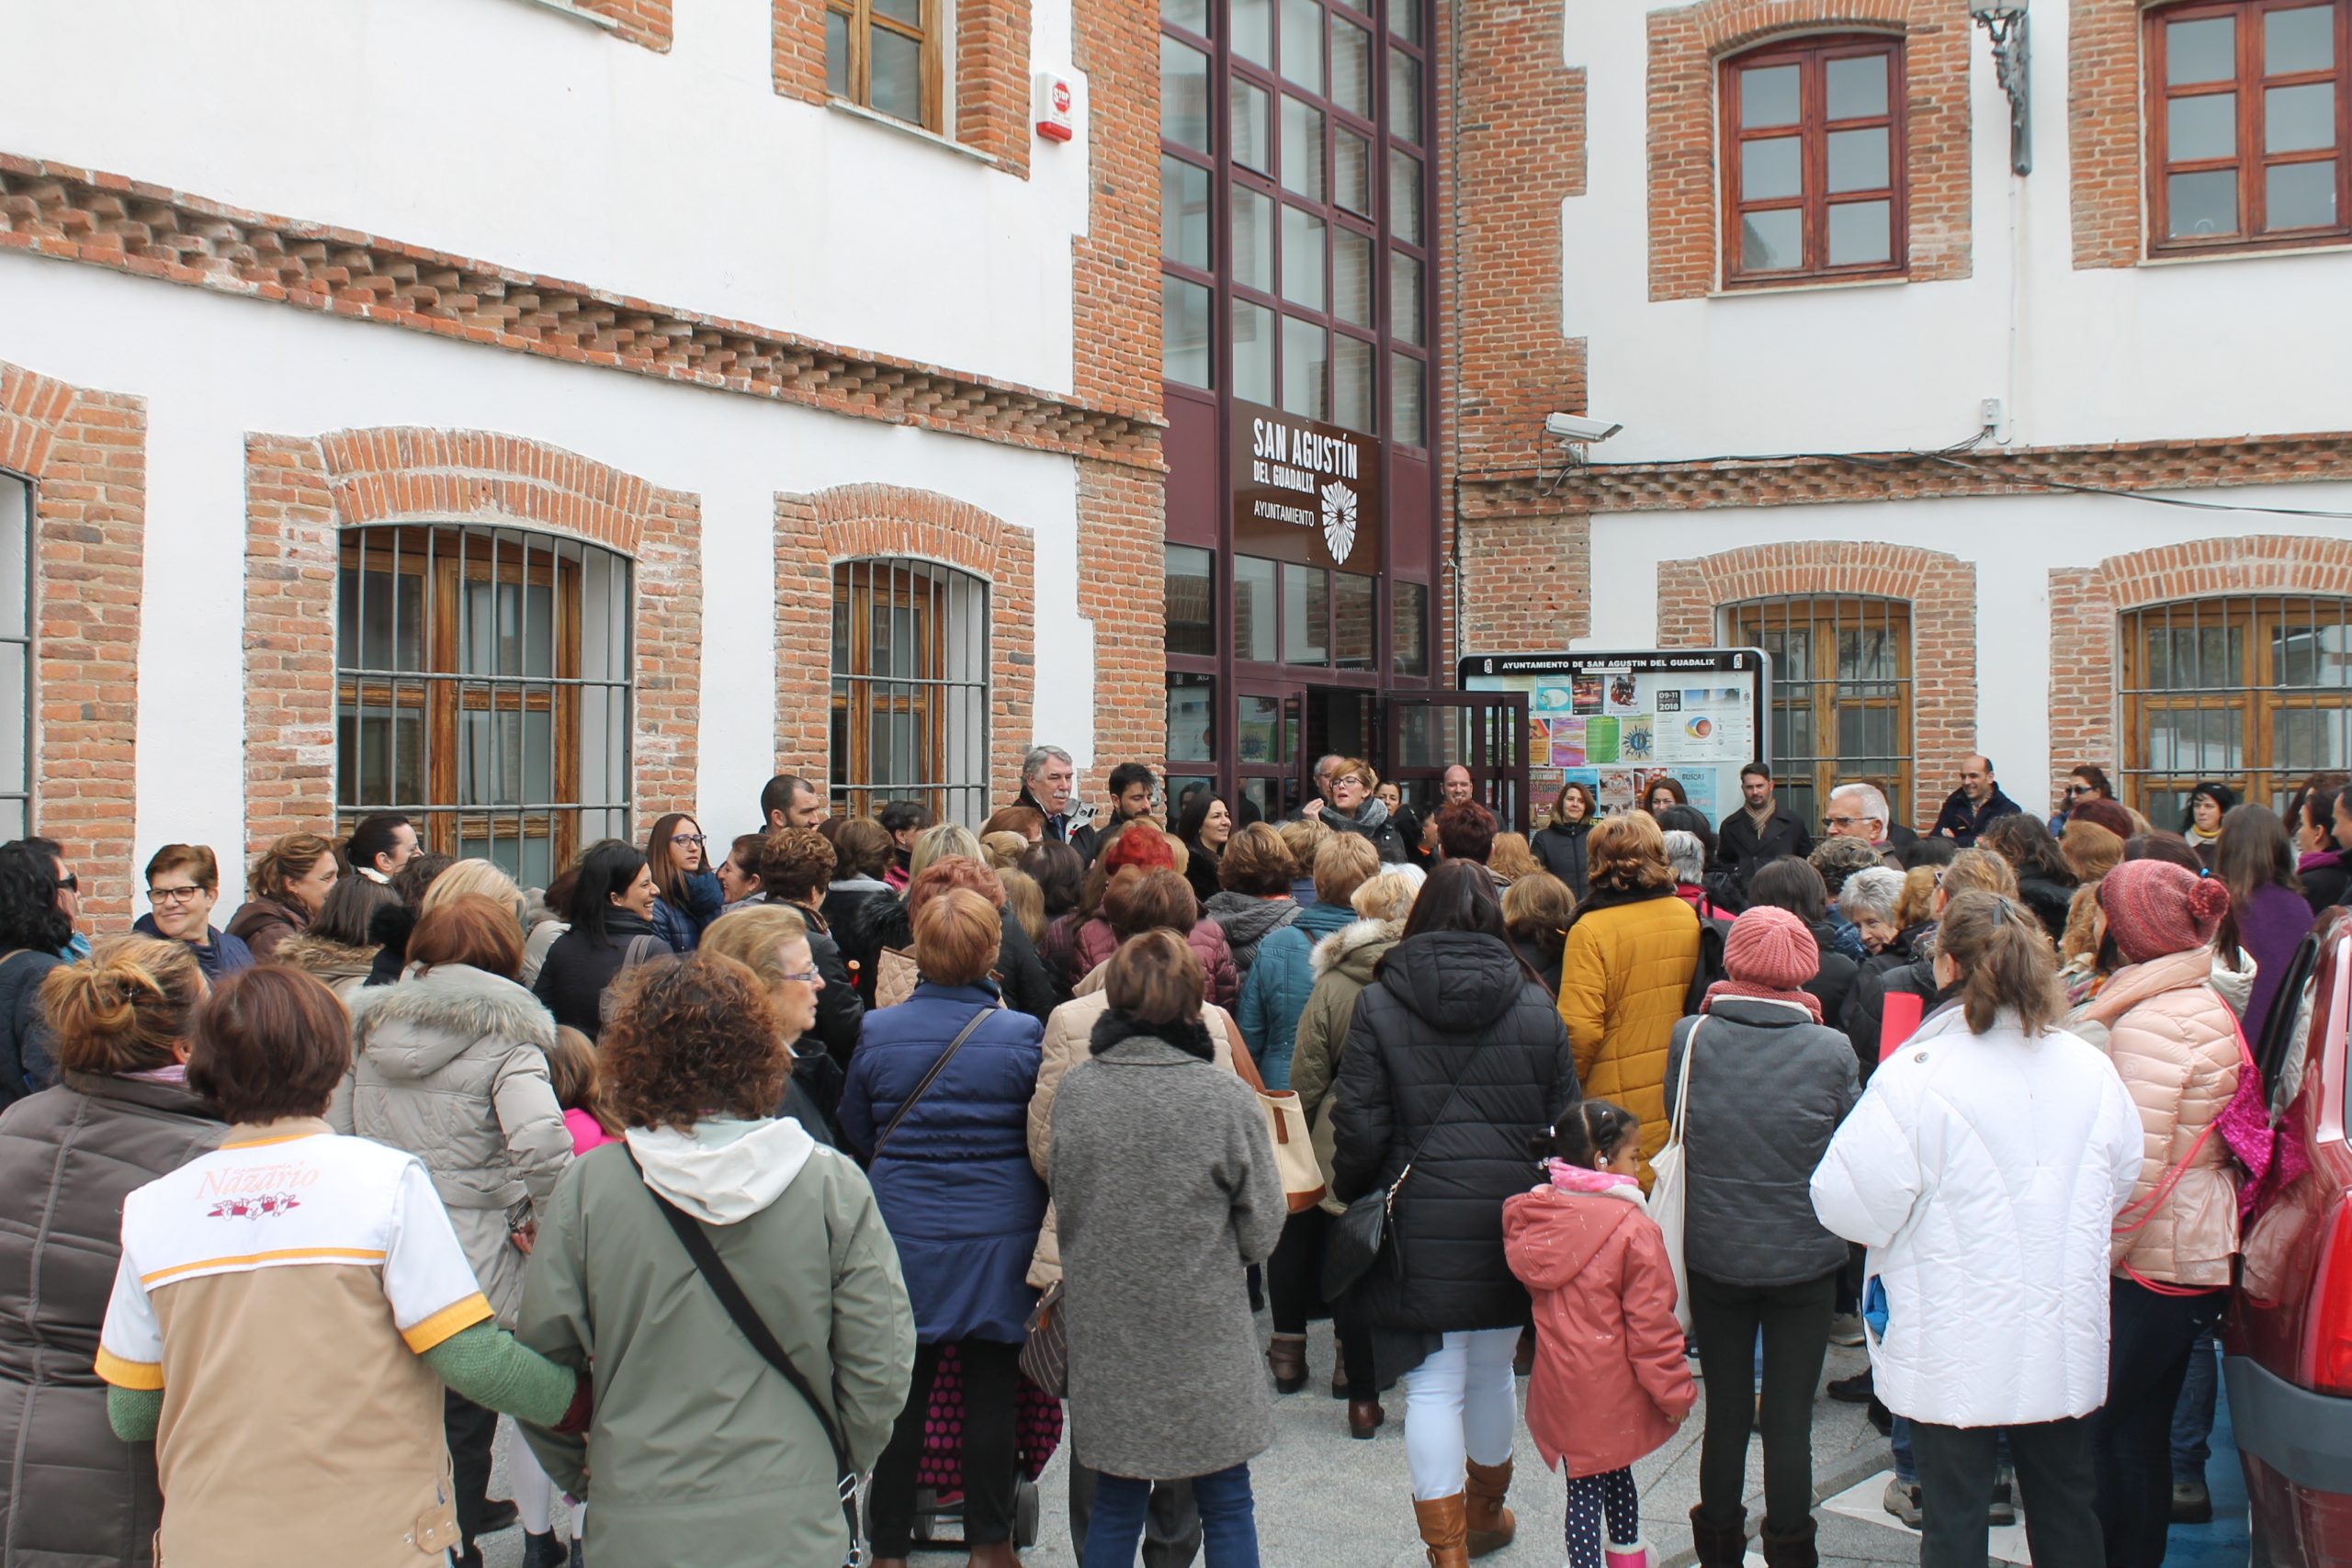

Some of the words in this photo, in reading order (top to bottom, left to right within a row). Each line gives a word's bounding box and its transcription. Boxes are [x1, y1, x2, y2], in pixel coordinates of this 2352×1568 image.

[1054, 88, 1069, 103] STOP
[1253, 418, 1286, 462] SAN
[1292, 428, 1358, 479] AGUSTÍN
[1253, 460, 1270, 484] DEL
[1273, 465, 1315, 494] GUADALIX
[1253, 500, 1315, 527] AYUNTAMIENTO
[1658, 703, 1679, 711] 2018
[196, 1161, 319, 1200] Nazario
